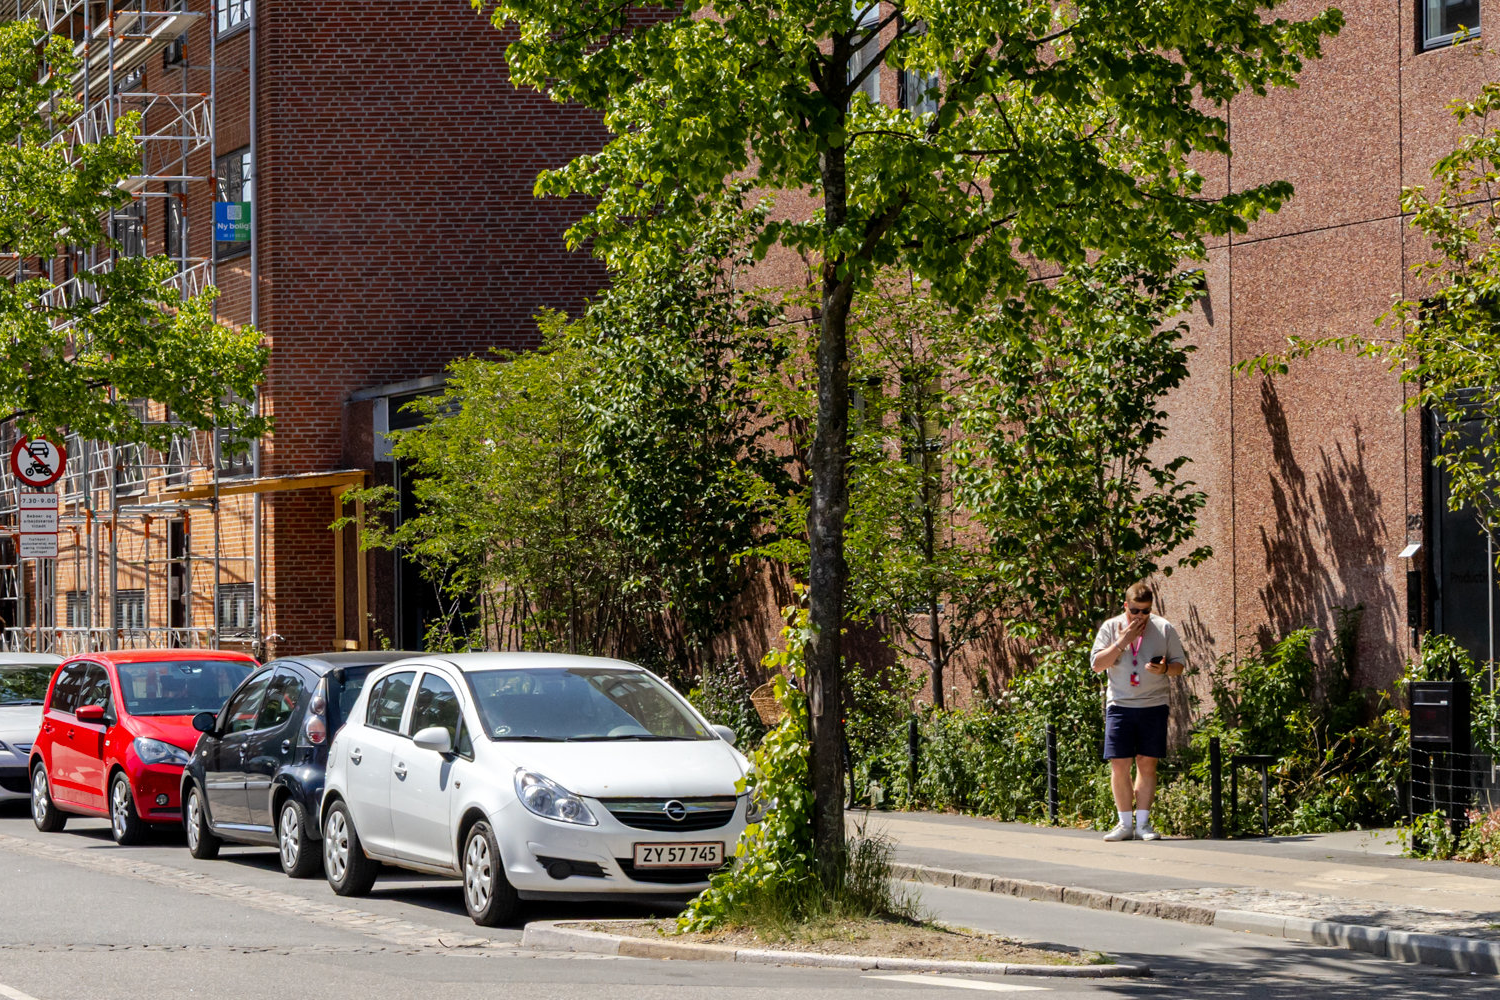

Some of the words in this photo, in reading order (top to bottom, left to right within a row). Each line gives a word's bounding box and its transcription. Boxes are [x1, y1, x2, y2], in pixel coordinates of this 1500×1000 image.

[217, 222, 228, 230] Ny
[643, 848, 664, 862] ZY
[668, 848, 686, 862] 57
[690, 846, 716, 861] 745
